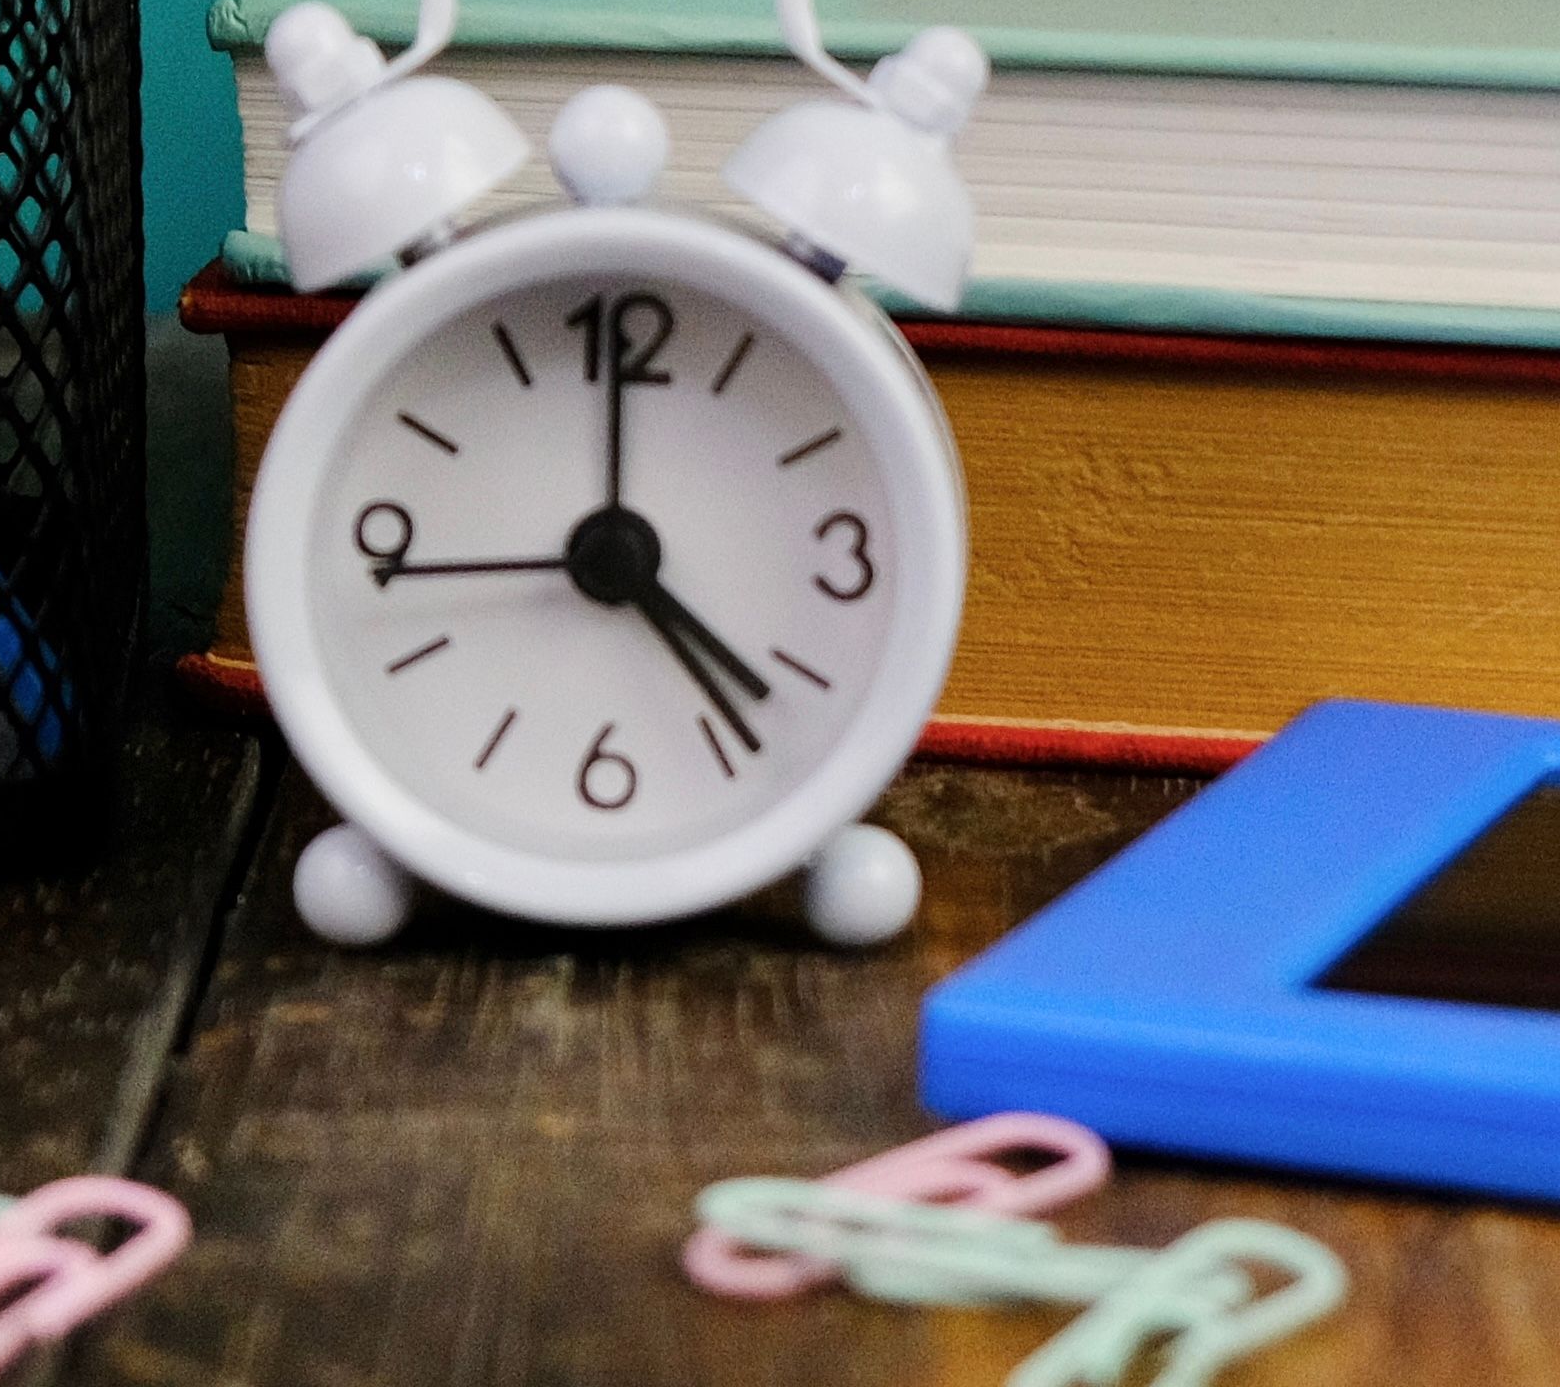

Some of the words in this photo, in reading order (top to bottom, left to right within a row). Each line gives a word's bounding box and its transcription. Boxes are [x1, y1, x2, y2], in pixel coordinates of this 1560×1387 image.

[564, 291, 675, 386] 12
[354, 501, 415, 591] 9
[813, 511, 875, 601] 3
[577, 721, 638, 811] 6
